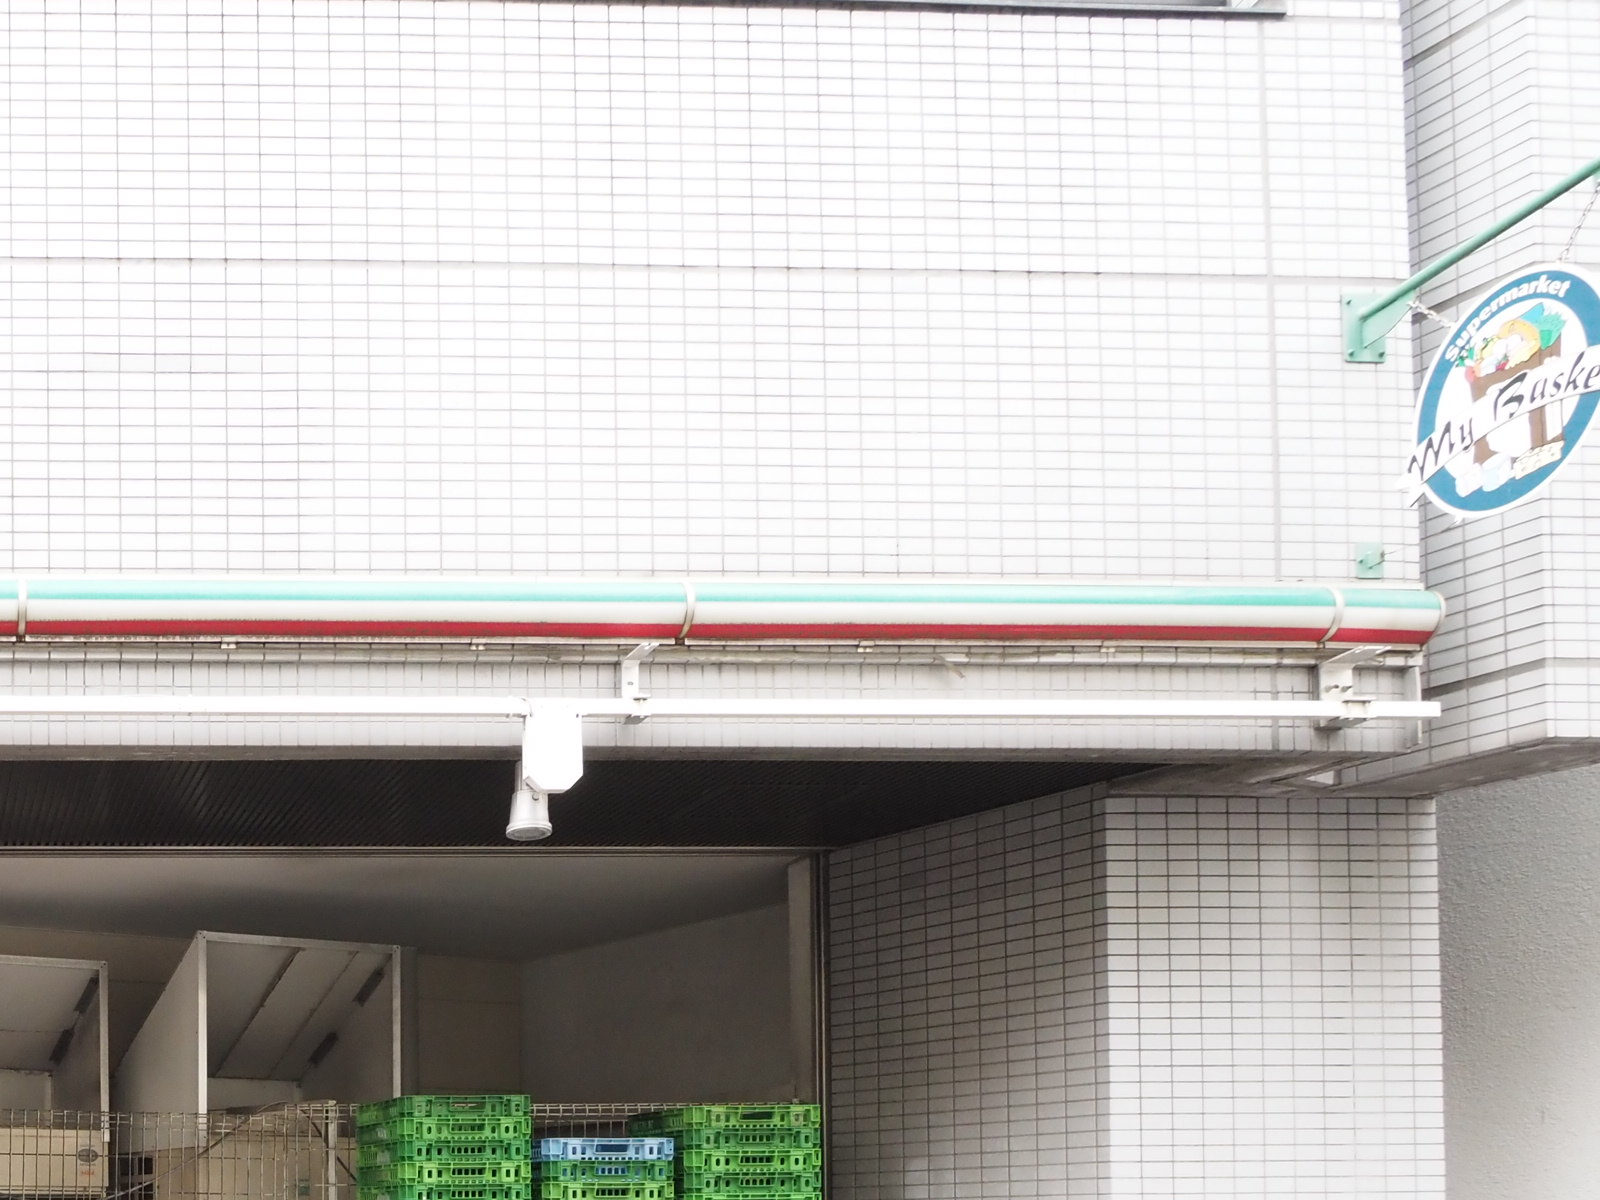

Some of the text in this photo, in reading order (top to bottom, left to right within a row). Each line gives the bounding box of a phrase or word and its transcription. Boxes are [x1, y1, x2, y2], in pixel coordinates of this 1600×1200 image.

[1445, 275, 1571, 361] Supermarket
[1408, 351, 1600, 481] My Baske
